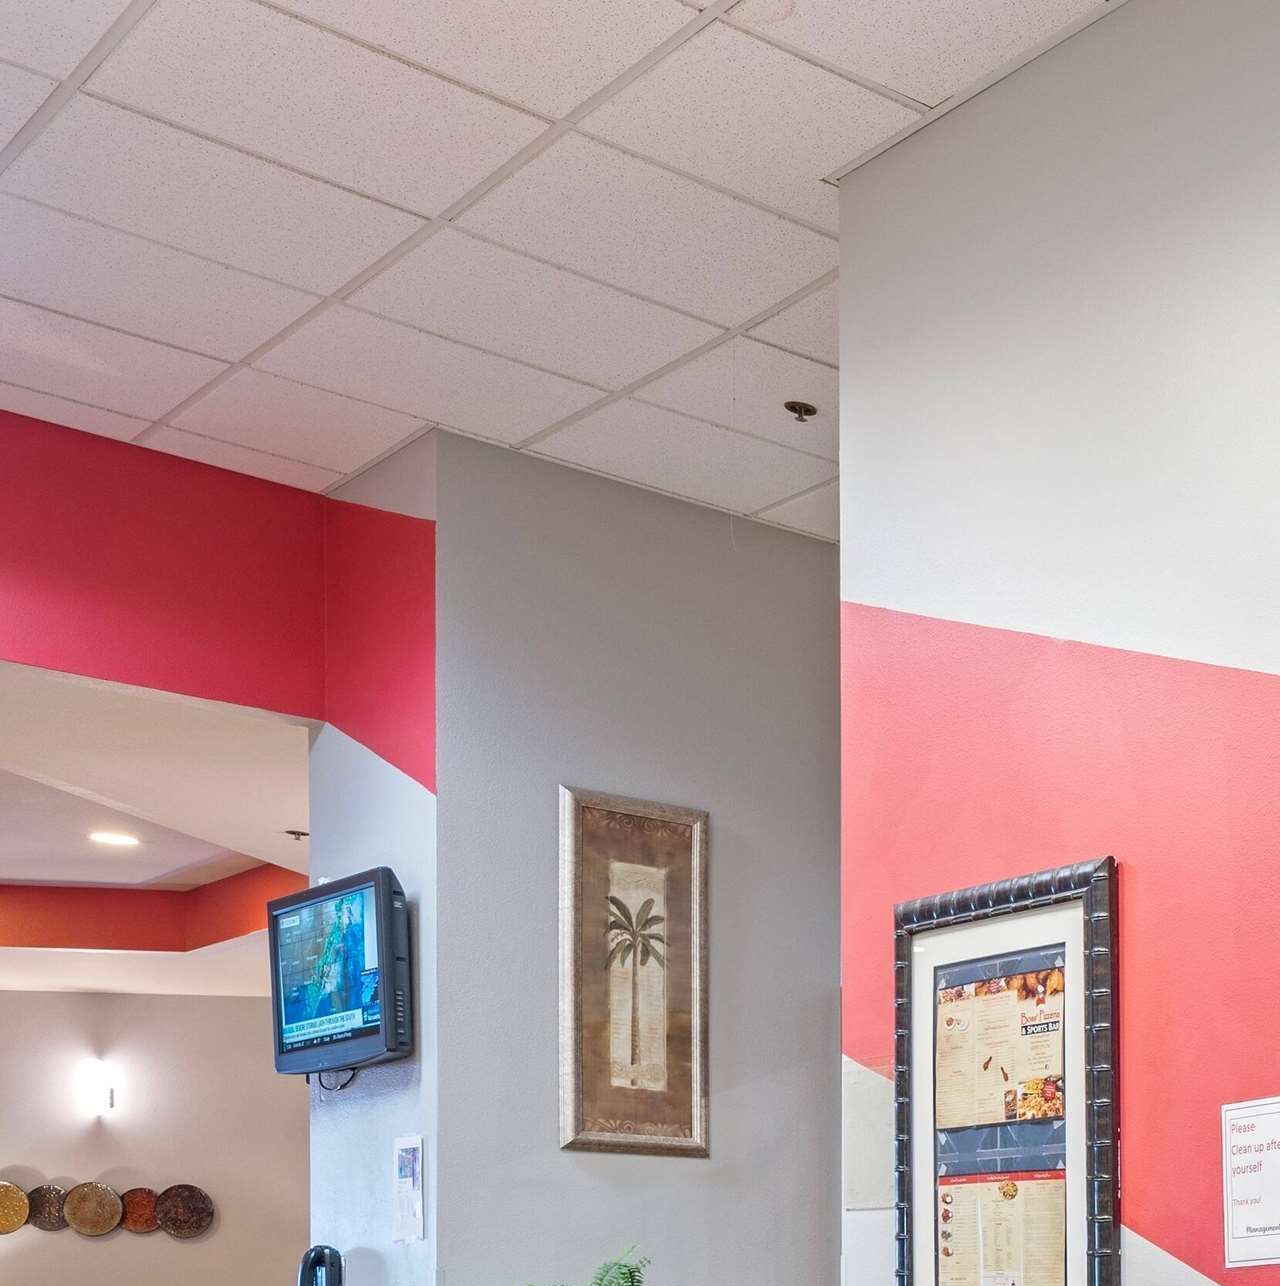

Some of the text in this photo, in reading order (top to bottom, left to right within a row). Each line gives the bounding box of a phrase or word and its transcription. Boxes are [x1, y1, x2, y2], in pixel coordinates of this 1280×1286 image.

[1231, 1121, 1256, 1134] Please
[1231, 1143, 1253, 1156] Clean
[1254, 1143, 1265, 1155] up
[1231, 1161, 1263, 1176] yourself
[1233, 1198, 1249, 1207] Thank
